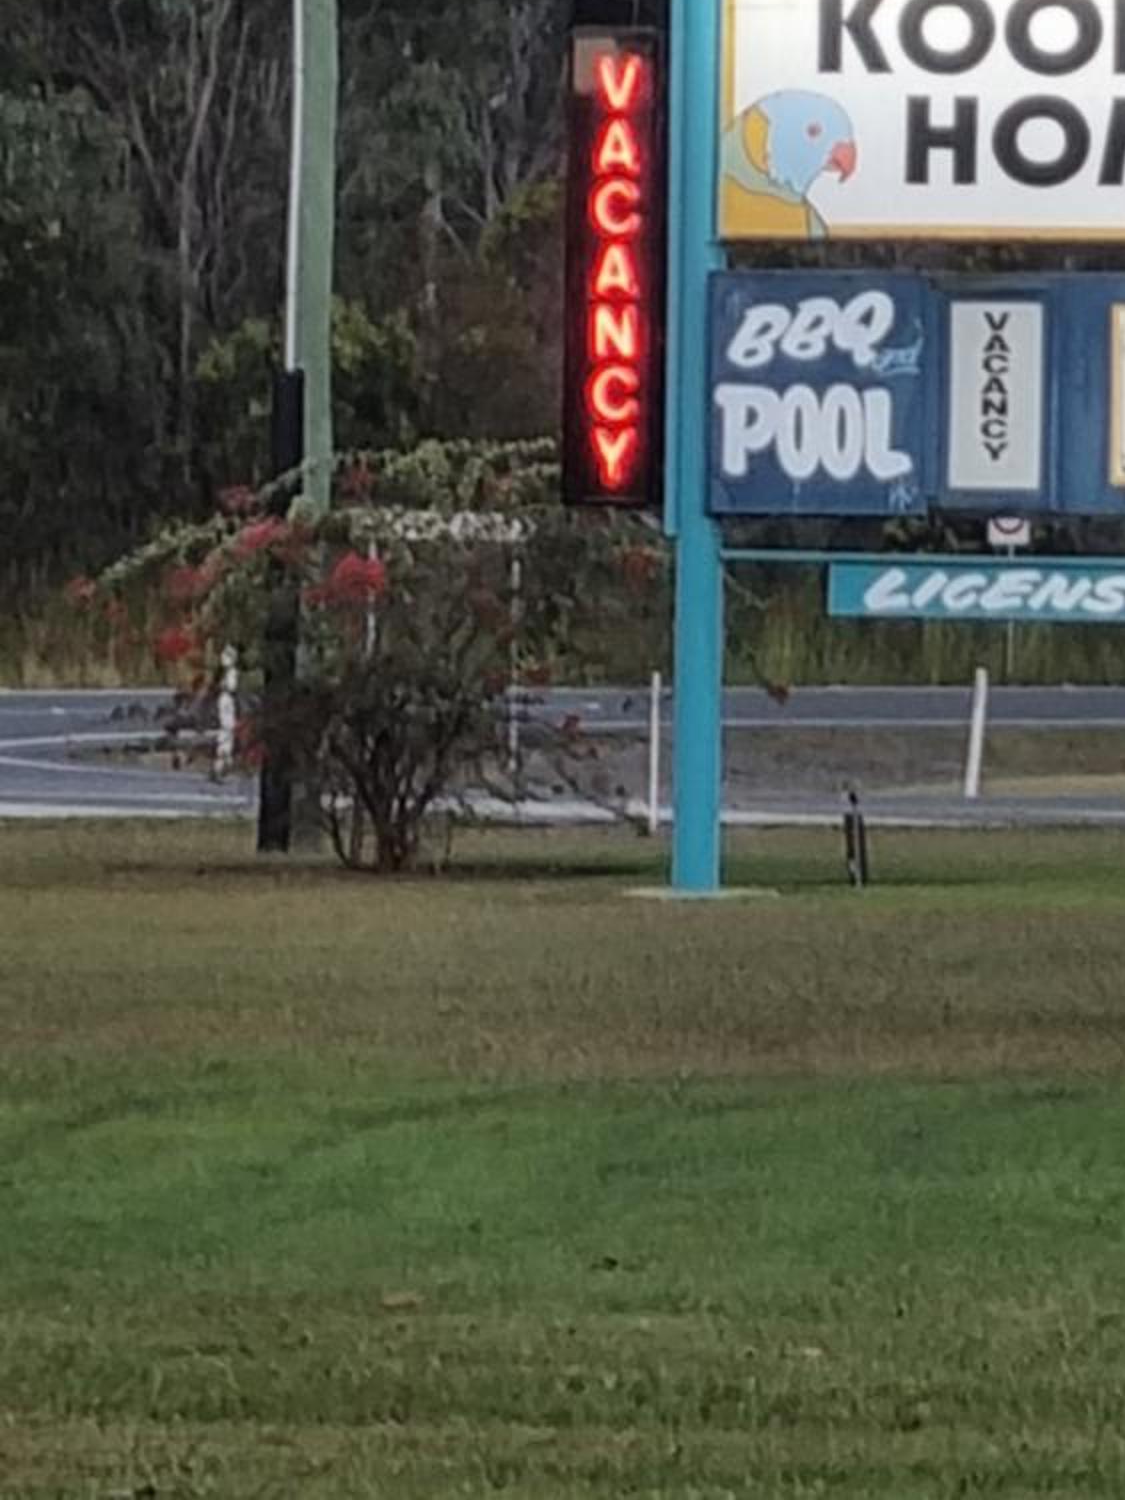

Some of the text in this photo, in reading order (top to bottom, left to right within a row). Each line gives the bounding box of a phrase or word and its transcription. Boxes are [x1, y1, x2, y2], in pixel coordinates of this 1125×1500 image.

[593, 52, 642, 490] VACANCY
[726, 290, 896, 368] BBQ
[713, 382, 914, 480] POOL
[980, 311, 1010, 461] VACANCY
